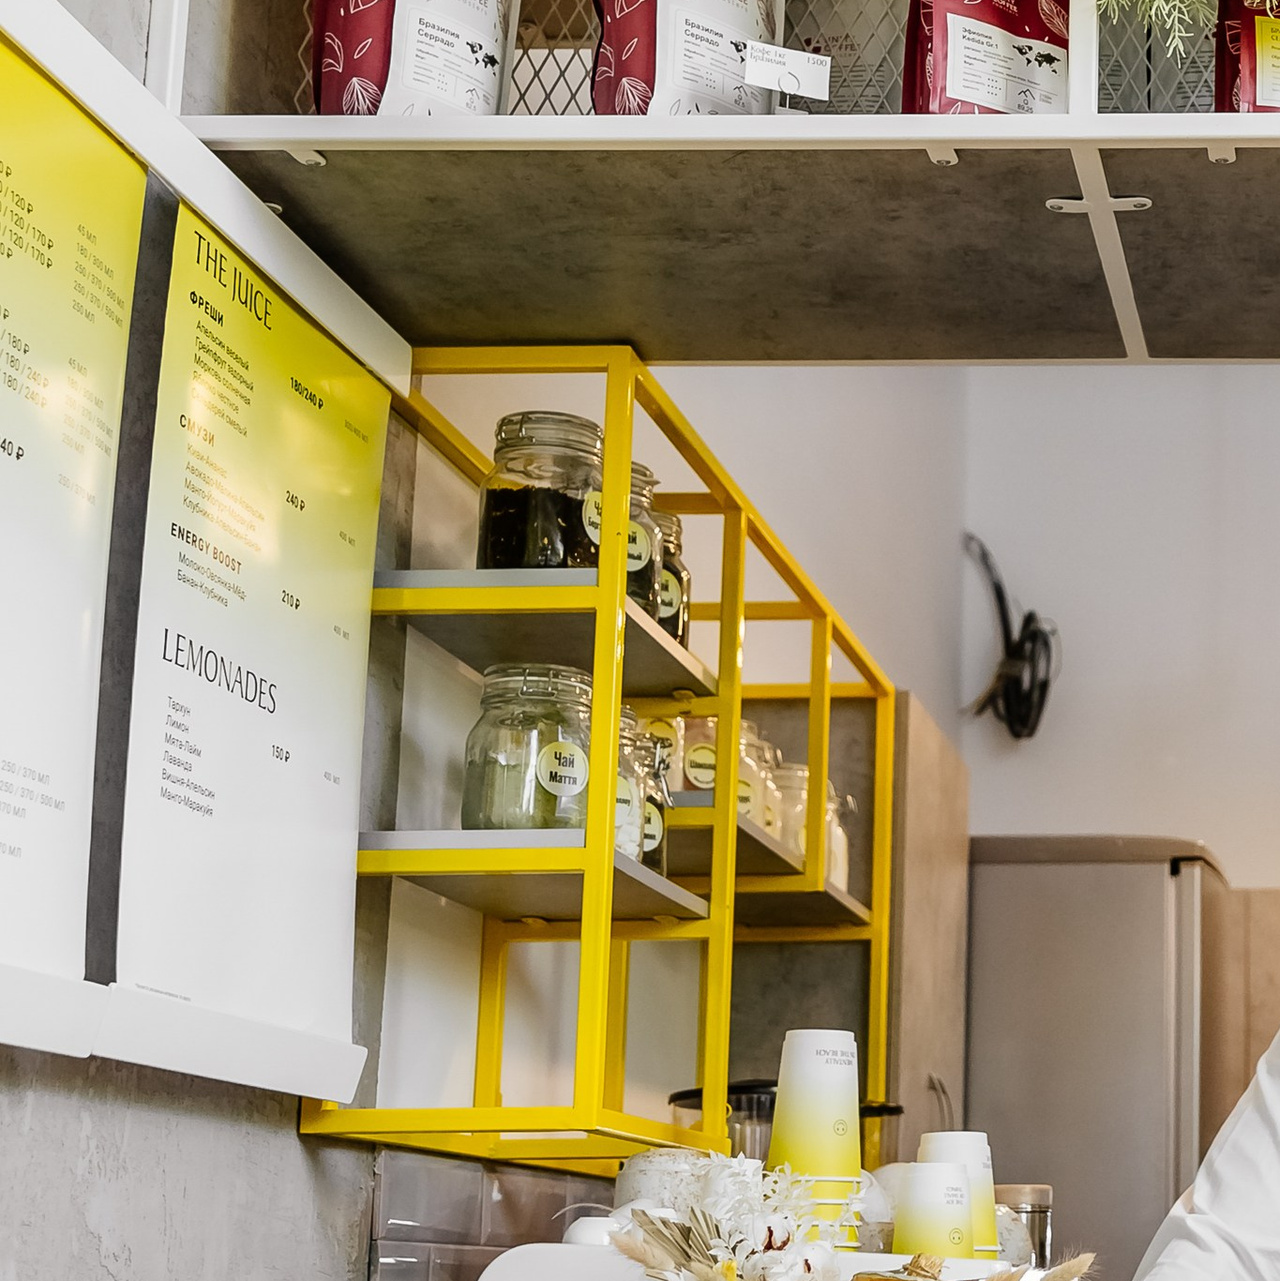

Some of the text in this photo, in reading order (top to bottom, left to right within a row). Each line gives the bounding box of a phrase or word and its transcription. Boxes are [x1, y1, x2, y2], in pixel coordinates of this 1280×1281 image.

[418, 18, 460, 39] Бразилия
[418, 28, 455, 48] Серрадо
[684, 18, 724, 40] Бразилия
[684, 29, 720, 48] Серрадо
[962, 27, 992, 40] Эфиопия
[750, 45, 772, 58] Кофе
[806, 57, 828, 68] 1500
[750, 53, 787, 67] Бразилия
[11, 190, 26, 211] 120
[10, 209, 25, 230] 120
[32, 226, 47, 247] 170
[9, 229, 24, 249] 120
[31, 245, 46, 266] 170
[194, 230, 272, 331] THE JUICE
[190, 291, 224, 327] ФРЕШИ
[7, 332, 23, 352] 180
[196, 320, 225, 350] Апельсин
[5, 352, 21, 372] 180
[195, 336, 227, 369] Грейпфрут
[194, 352, 221, 383] Морковь
[3, 372, 18, 391] 180
[290, 376, 317, 408] 180/240
[180, 414, 215, 447] СМУЗИ
[286, 490, 299, 510] 240
[170, 522, 242, 574] ENERGY BOOST
[177, 569, 228, 607] Банан-Клубника
[282, 589, 295, 608] 210
[162, 627, 278, 715] LEMONADES
[167, 696, 191, 718] Тархун
[165, 715, 190, 735] Лимон
[164, 732, 202, 759] Мята-Лайм
[272, 744, 284, 762] 150
[1, 760, 16, 774] 250
[22, 766, 36, 781] 370
[163, 751, 193, 773] Лаванда
[553, 750, 575, 769] Чай
[161, 768, 216, 801] Вишня-Апельсин
[549, 771, 578, 787] Маття
[20, 787, 34, 801] 370
[160, 786, 214, 818] Манго-Маракуйя
